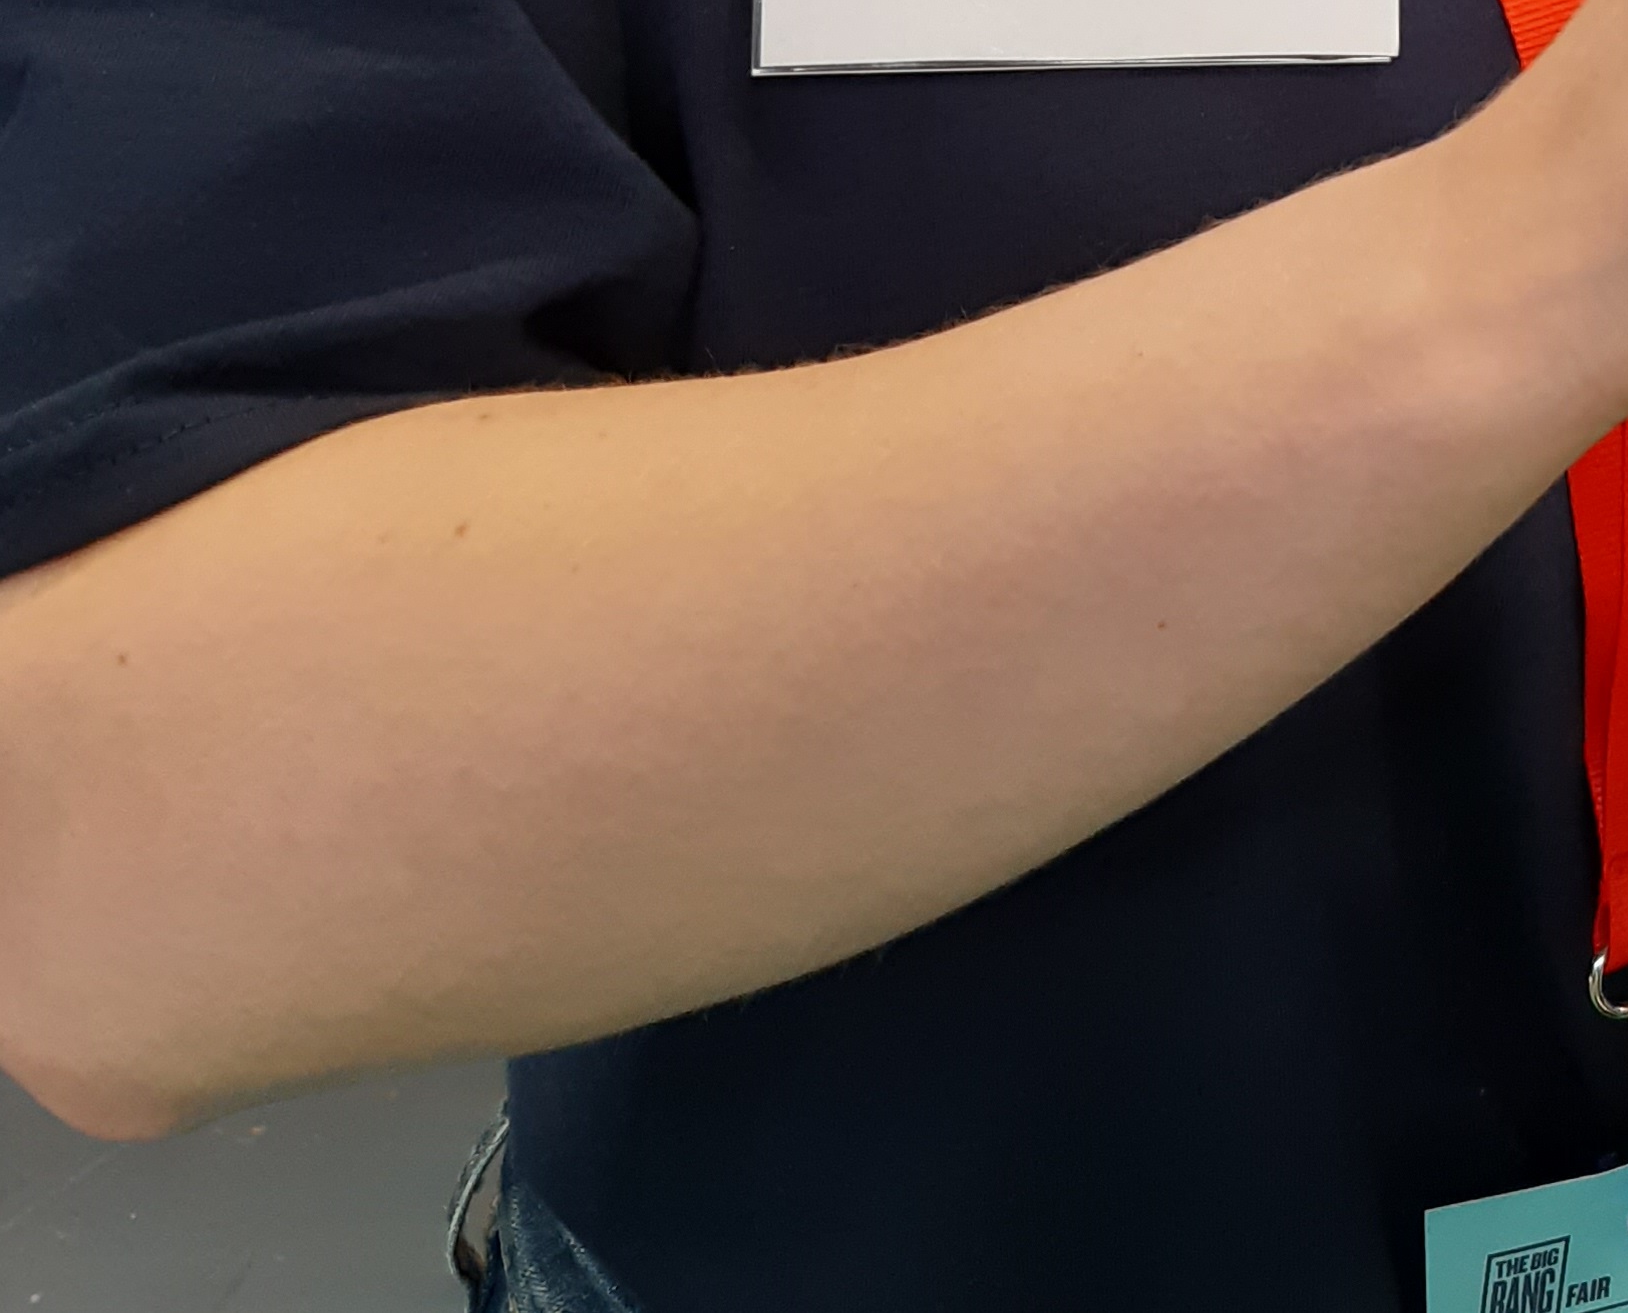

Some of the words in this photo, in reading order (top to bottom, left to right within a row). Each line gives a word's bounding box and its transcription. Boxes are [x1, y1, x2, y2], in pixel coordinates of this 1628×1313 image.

[1495, 1254, 1530, 1279] THE
[1530, 1247, 1560, 1271] BIG
[1565, 1275, 1612, 1309] FAIR
